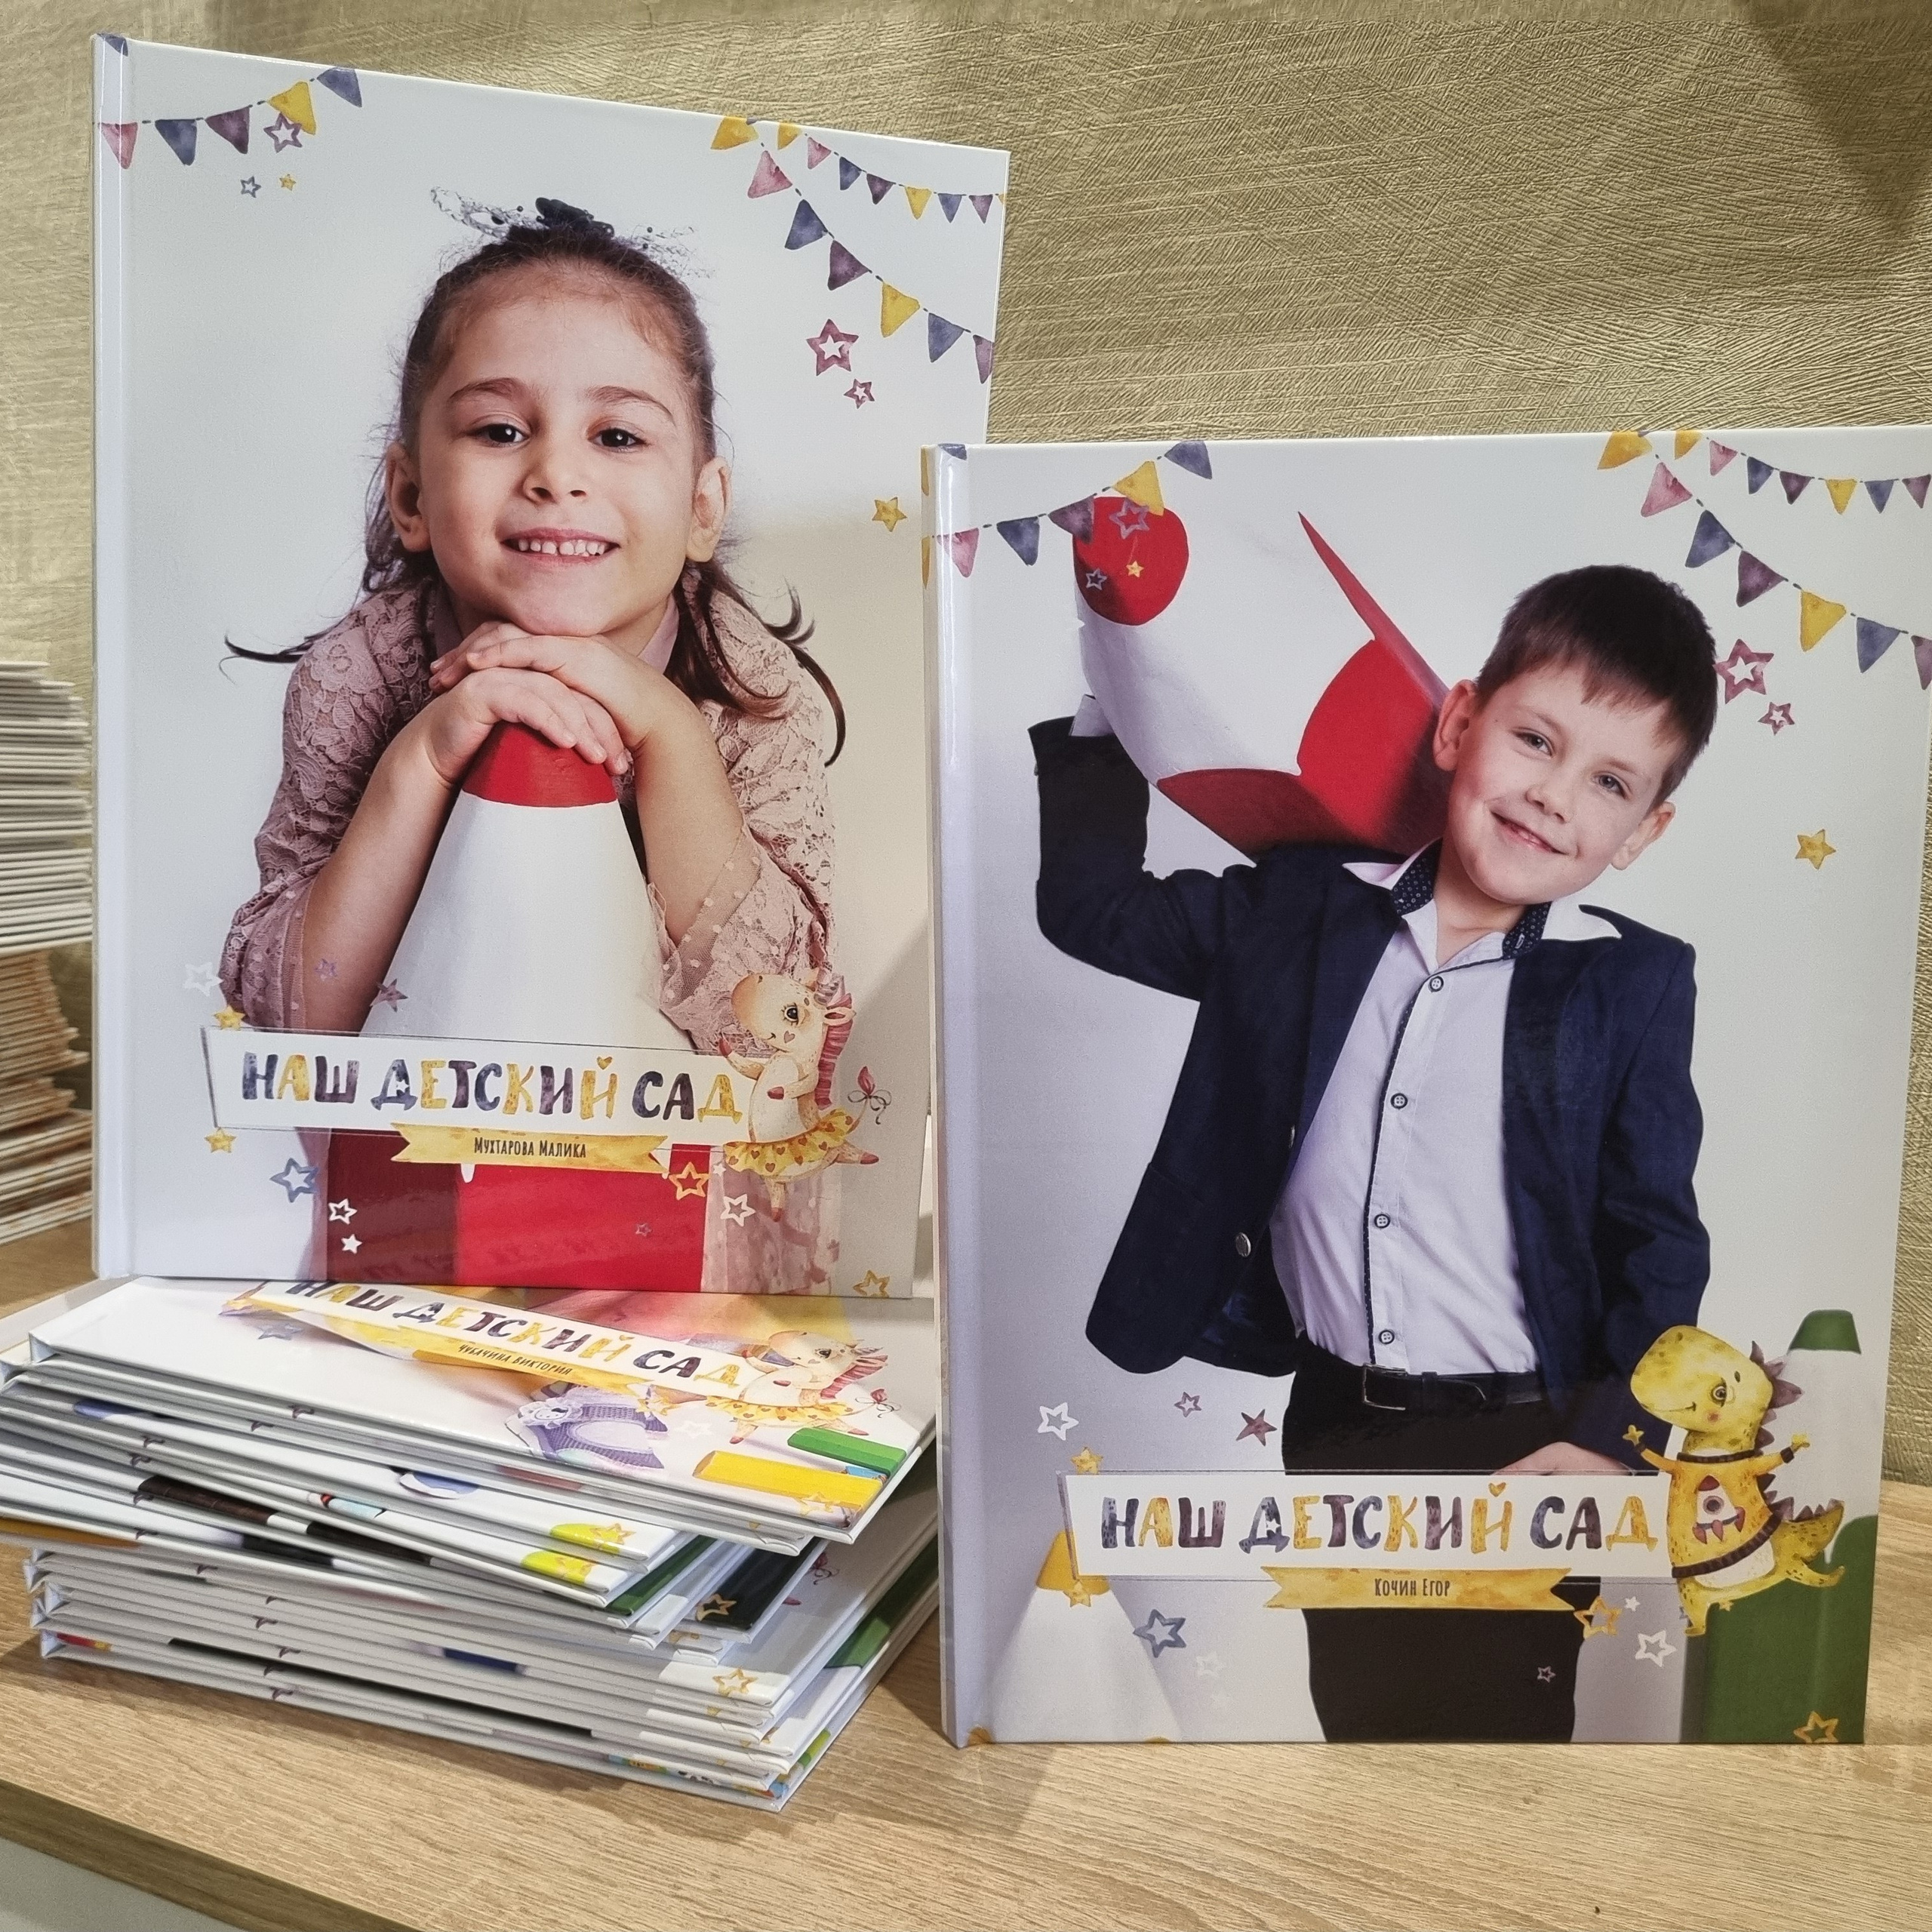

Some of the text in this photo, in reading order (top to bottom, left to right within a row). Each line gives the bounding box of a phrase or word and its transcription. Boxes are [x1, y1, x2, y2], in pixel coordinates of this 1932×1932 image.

[242, 1051, 743, 1124] НАШ ДЕТСКИЙ САД
[285, 1282, 740, 1387] НАШ ДЕТСКИЙ САД
[1101, 1481, 1658, 1554] НАШ ДЕТСКИЙ САД
